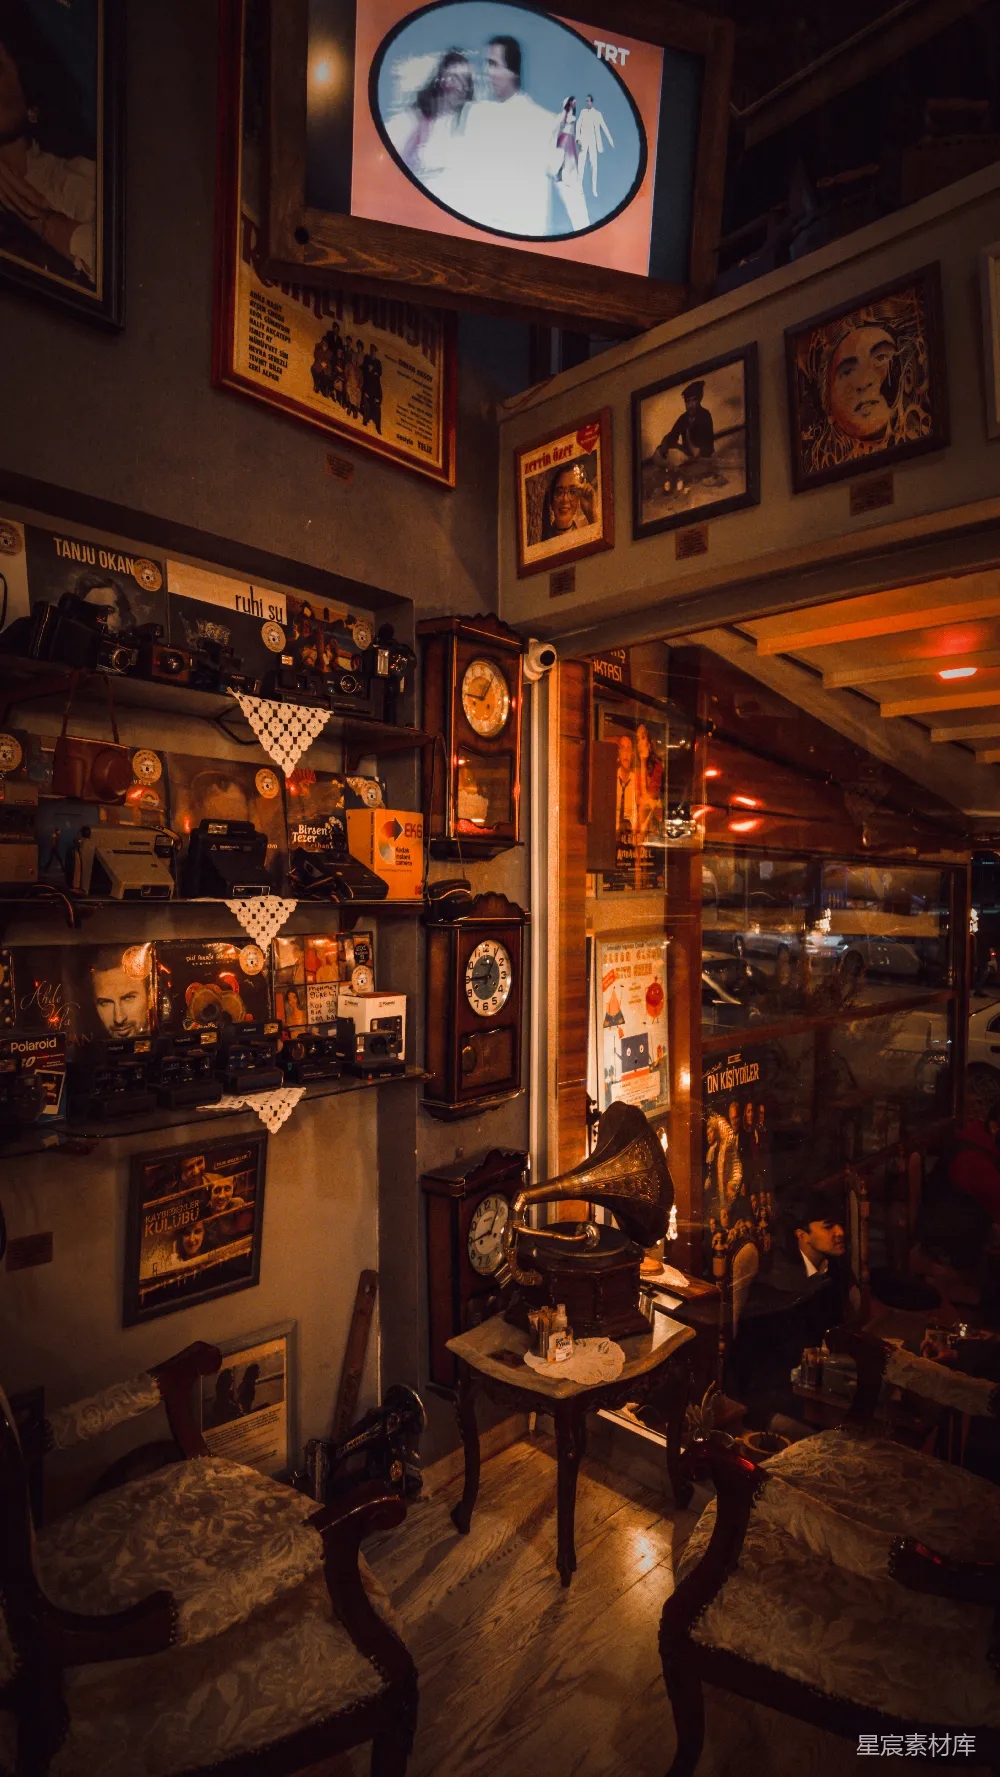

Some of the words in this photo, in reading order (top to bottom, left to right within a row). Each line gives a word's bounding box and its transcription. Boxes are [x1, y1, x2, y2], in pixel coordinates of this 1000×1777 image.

[594, 40, 630, 66] TRT
[54, 538, 96, 565] TANJU
[99, 551, 134, 576] OKAN
[236, 586, 263, 618] ruhi
[268, 604, 283, 622] su
[292, 831, 318, 843] Tezer
[298, 824, 328, 836] Birsen
[483, 1002, 488, 1010] 6
[11, 1037, 57, 1052] Polaroid
[720, 1062, 759, 1091] KİŞİYDİLER
[145, 1207, 200, 1238] KULÜBÜ
[146, 1200, 200, 1223] KAYBEDENLER
